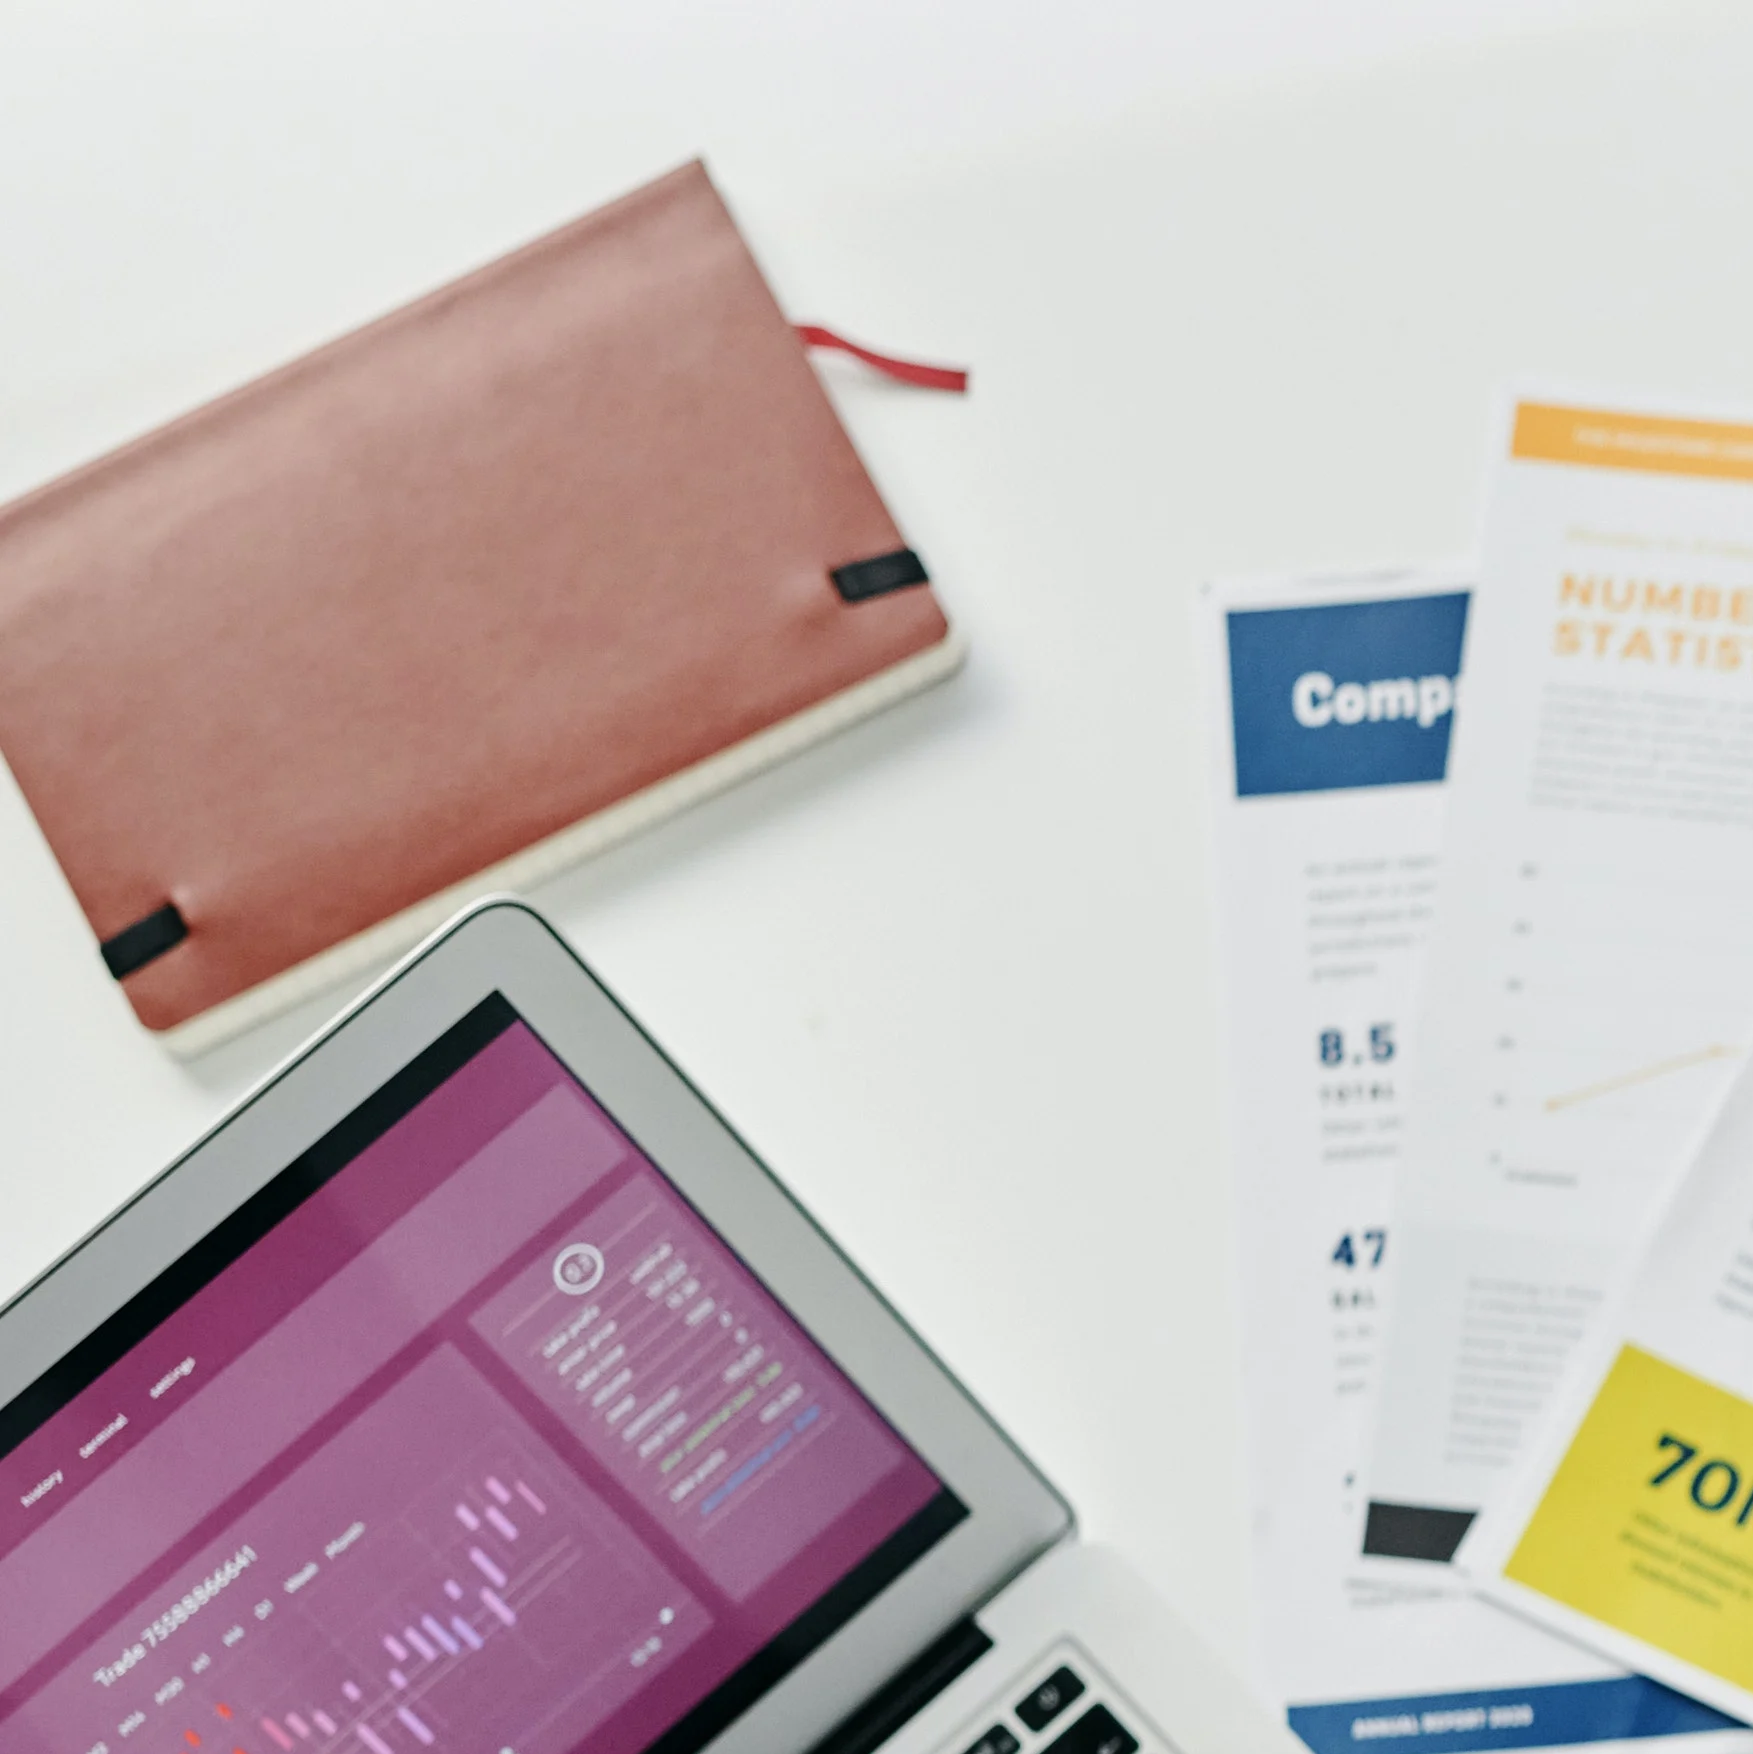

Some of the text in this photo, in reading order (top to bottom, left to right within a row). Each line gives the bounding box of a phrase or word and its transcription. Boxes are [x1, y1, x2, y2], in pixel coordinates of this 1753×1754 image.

[1291, 670, 1458, 729] Comp
[1319, 1025, 1395, 1067] 8.5
[1332, 1231, 1385, 1267] 47
